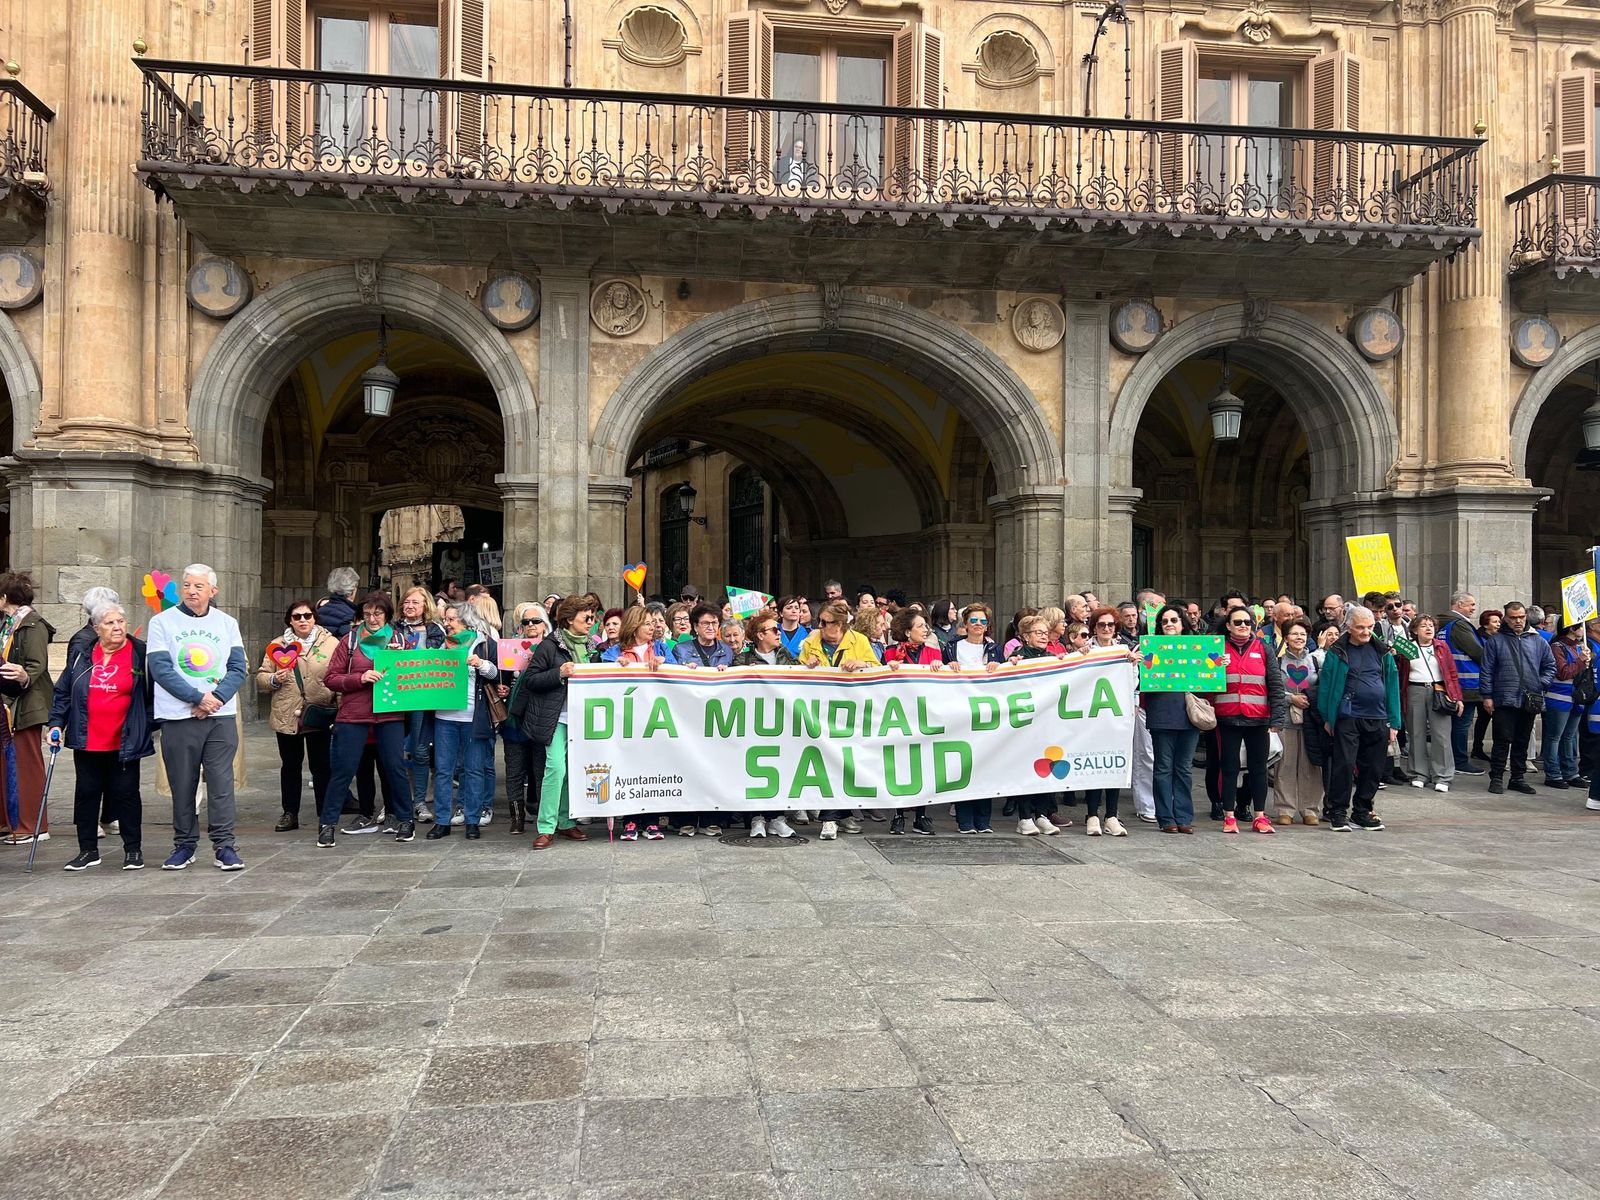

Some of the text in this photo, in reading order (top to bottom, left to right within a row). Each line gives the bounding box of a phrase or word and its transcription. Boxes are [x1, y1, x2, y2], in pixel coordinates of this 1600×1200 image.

[175, 629, 221, 643] ASAPAR
[397, 671, 454, 681] PARKINSON
[397, 680, 456, 691] SALAMANCA
[584, 677, 1123, 740] DÍA MUNDIAL DE LA
[745, 740, 973, 799] SALUD
[1073, 755, 1126, 771] SALUD
[614, 774, 683, 788] Ayuntamiento
[615, 787, 682, 800] de Salamanca
